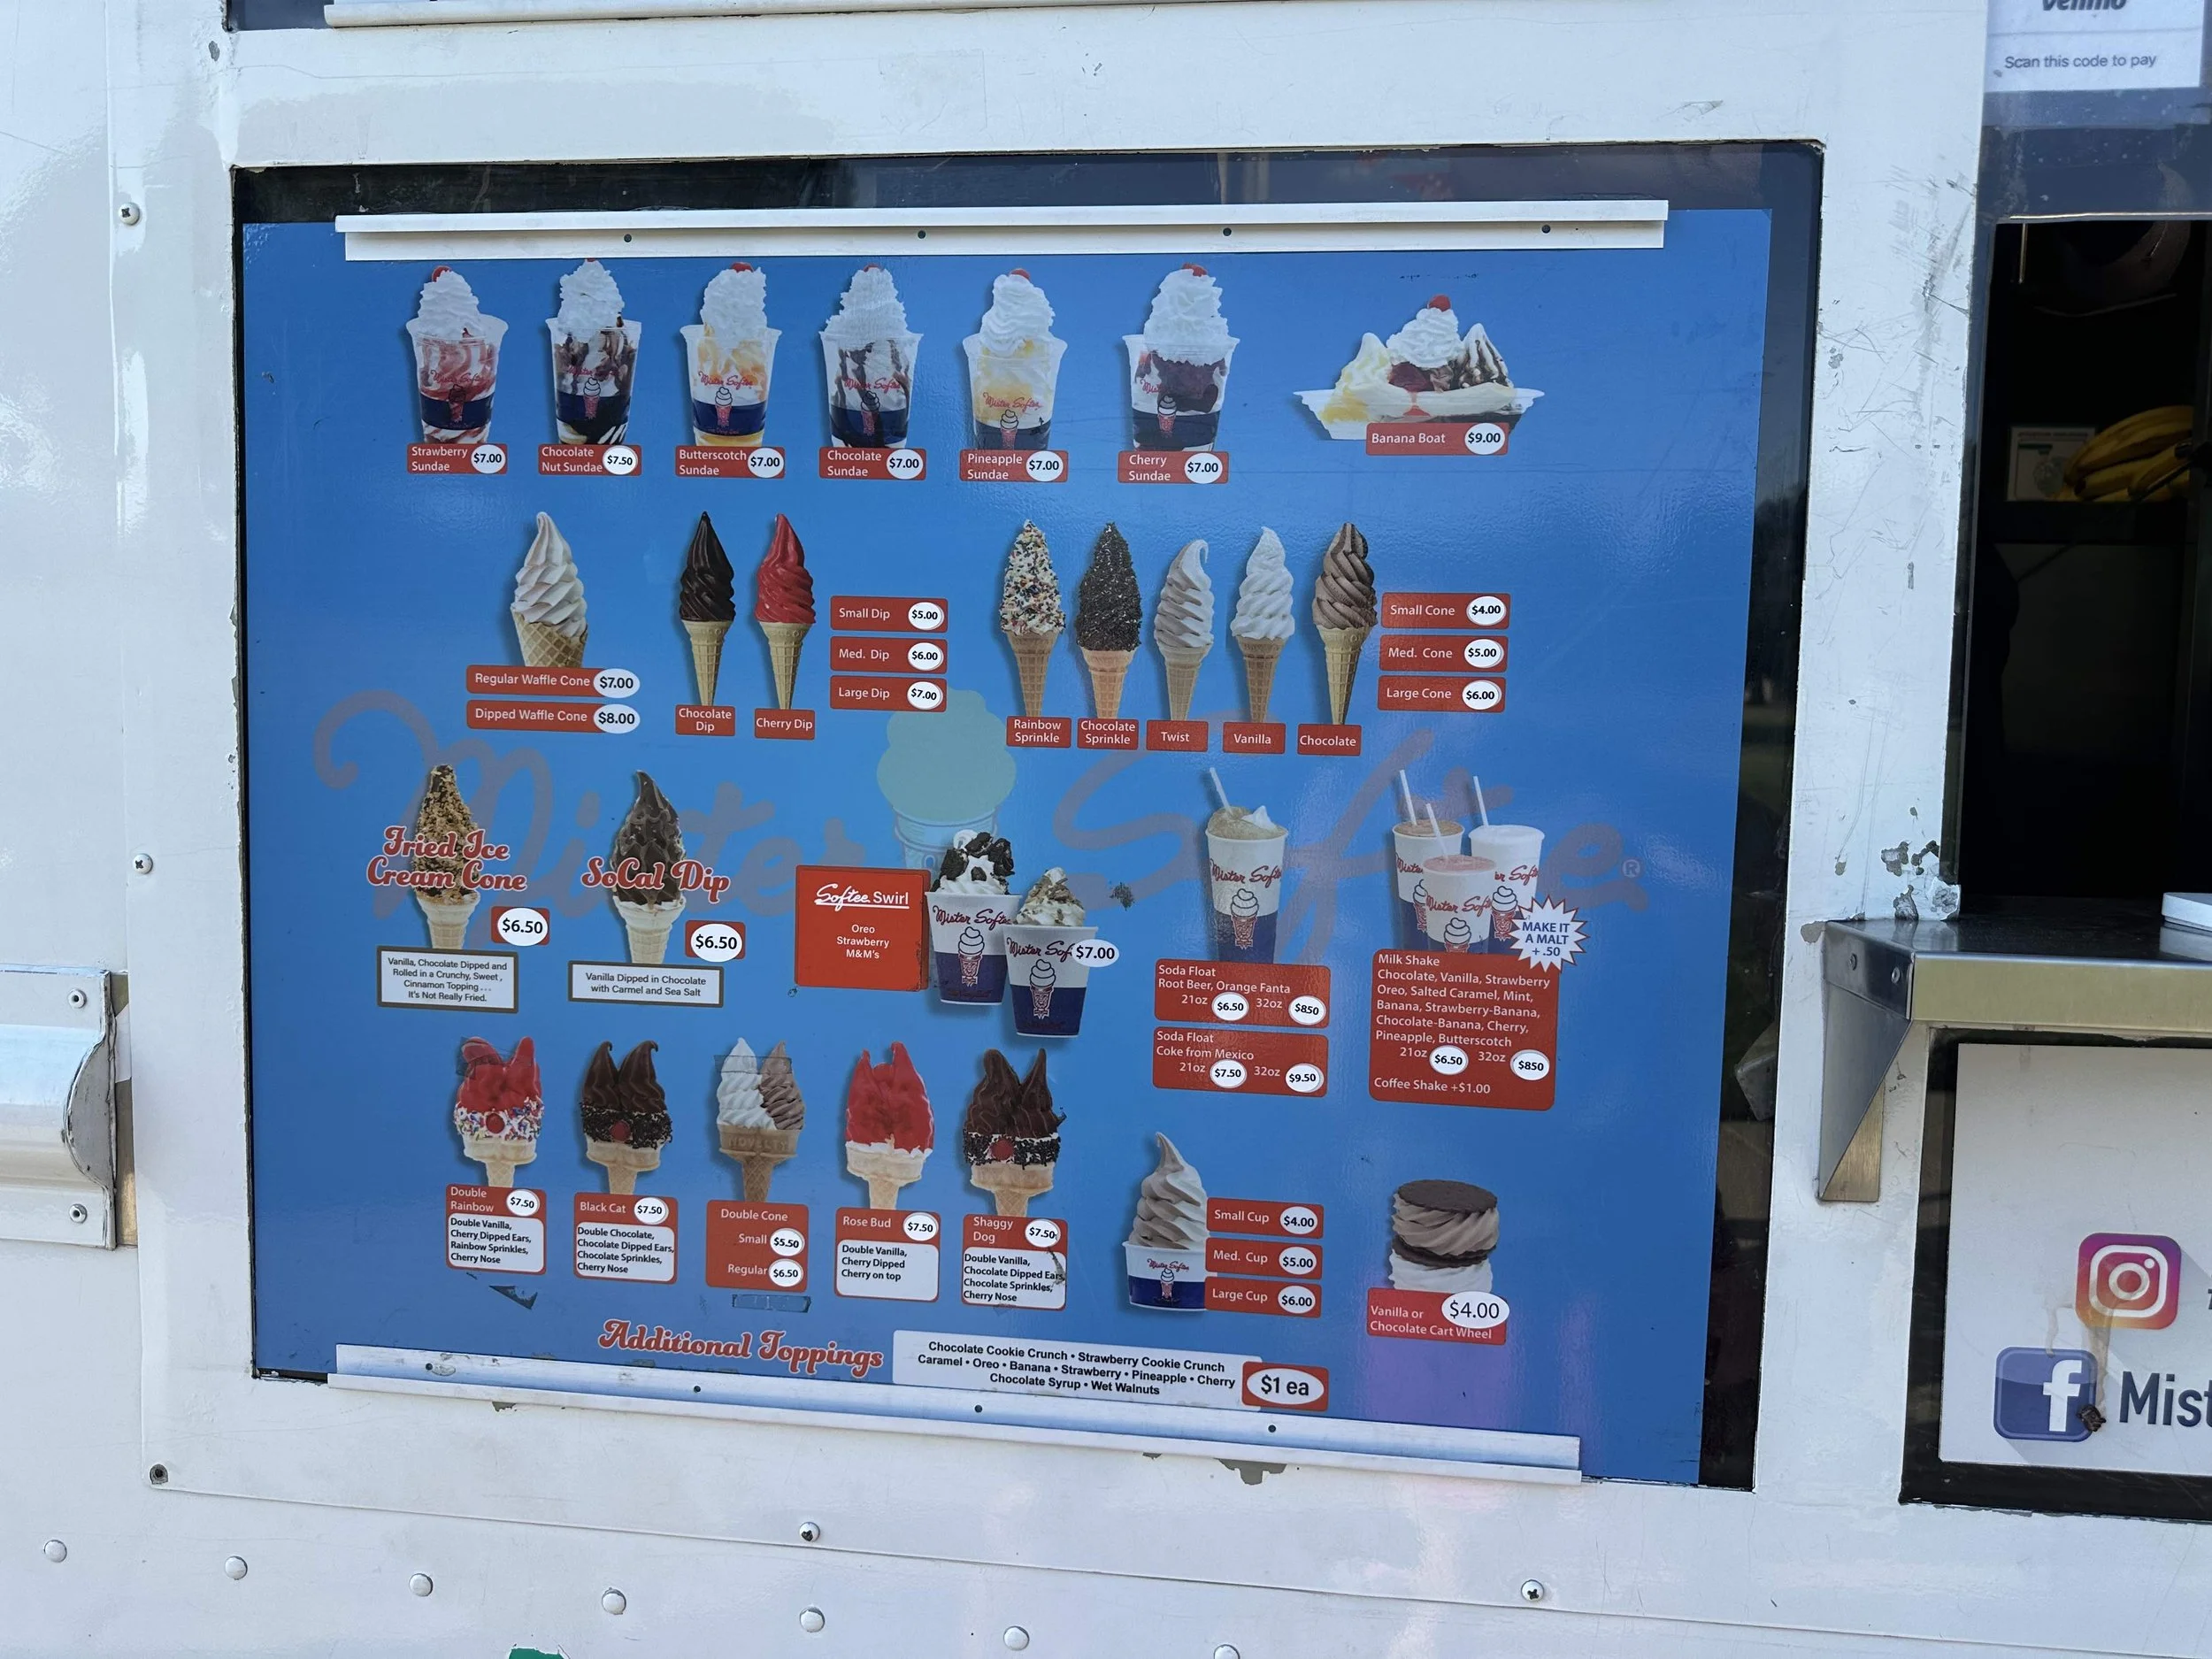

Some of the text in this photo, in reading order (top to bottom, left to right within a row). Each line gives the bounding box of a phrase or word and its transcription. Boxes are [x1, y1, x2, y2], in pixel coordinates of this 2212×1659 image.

[2005, 55, 2156, 69] Scan this code to pay
[1371, 434, 1446, 443] Banana Boat
[1468, 433, 1501, 444] $9.00
[411, 447, 467, 458] Strawberry
[541, 447, 594, 457] Chocolate
[680, 450, 747, 461] Butterscotch
[473, 453, 502, 464] $7.00
[607, 454, 633, 466] $7.50
[750, 457, 780, 468] $7.00
[967, 454, 1022, 466] Pineapple
[411, 462, 449, 472] Sundae
[541, 462, 603, 472] Nut Sundae
[680, 465, 719, 475] Sundae
[1028, 459, 1060, 471] $7.00
[967, 470, 1009, 480] Sundae
[839, 608, 890, 620] Small Dip
[911, 610, 938, 619] $5.00
[839, 649, 889, 661] Med. Dip
[911, 651, 938, 660] $6.00
[474, 673, 590, 687] Regular Waffle Cone
[599, 676, 634, 690] $7.00
[839, 687, 890, 700] Large Dip
[911, 688, 937, 700] $7.00
[679, 708, 732, 719] Chocolate
[695, 721, 715, 733] Dip
[757, 718, 813, 731] Cherry Dip
[1160, 732, 1189, 742] Twist
[1233, 733, 1271, 745] Vanilla
[1300, 735, 1356, 747] Chocolate
[383, 826, 511, 860] Fried Ice
[366, 855, 527, 891] Cream Cone
[580, 856, 730, 903] SoCal Dip
[815, 883, 910, 911] Softee Swirl
[503, 918, 542, 934] $6.50
[851, 924, 875, 934] Oreo
[1522, 922, 1571, 933] MAKE IT
[695, 933, 738, 949] $6.50
[836, 936, 890, 949] Strawberry
[1525, 934, 1569, 945] A MALT
[846, 949, 879, 959] M&M's
[1075, 946, 1116, 959] $7.00
[1379, 954, 1440, 966] Milk Shake
[1158, 964, 1216, 977] Soda Float
[586, 972, 614, 981] Vanilla
[617, 974, 649, 984] Dipped
[662, 976, 706, 985] Chocolate
[1378, 970, 1550, 989] Chocolate, Vanilla, Strawberry
[684, 987, 701, 996] Salt
[1158, 979, 1290, 994] Root Beer, Orange Fanta
[1378, 985, 1533, 1002] Oreo, Salted Caramel, Mint,
[1181, 995, 1208, 1005] 21oz
[1217, 1002, 1243, 1011] $6.50
[1256, 998, 1283, 1009] 32oz
[1377, 1000, 1540, 1018] Banana, Strawberry-Banana,
[1376, 1016, 1529, 1033] Chocolate-Banana, Cherry,
[1376, 1031, 1511, 1047] Pineapple, Butterscotch
[1374, 1078, 1491, 1094] Coffee Shake +$1.00
[450, 1187, 487, 1198] Double
[450, 1202, 494, 1212] Rainbow
[511, 1197, 534, 1209] $7.50
[580, 1202, 626, 1213] Black Cat
[637, 1205, 662, 1215] $7.50
[450, 1218, 511, 1231] Double Vanilla,
[842, 1217, 891, 1228] Rose Bud
[908, 1222, 933, 1233] $7.50
[973, 1217, 1013, 1230] Shaggy
[450, 1230, 531, 1243] Cherry Dipped Ears,
[973, 1232, 995, 1244] Dog
[1029, 1227, 1055, 1239] $7.50
[450, 1241, 528, 1255] Rainbow Sprinkles,
[842, 1245, 907, 1257] Double Vanilla,
[450, 1253, 501, 1263] Cherry Nose
[842, 1257, 905, 1269] Cherry Dipped
[841, 1269, 871, 1279] Cherry
[886, 1271, 902, 1282] top
[1371, 1306, 1424, 1318] Vanilla or
[1449, 1300, 1499, 1319] $4.00
[1371, 1321, 1492, 1339] Chocolate Cart Wheel
[597, 1318, 884, 1379] Additional Toppings
[929, 1341, 1225, 1372] Chocolate Cookie Crunch Strawberry Cookie Crunch
[918, 1355, 1235, 1389] Caramel Oreo Banana Strawberry Pineapple Cherry
[990, 1373, 1160, 1395] Chocolate Syrup Wet Walnuts
[1261, 1374, 1310, 1395] $1 ea
